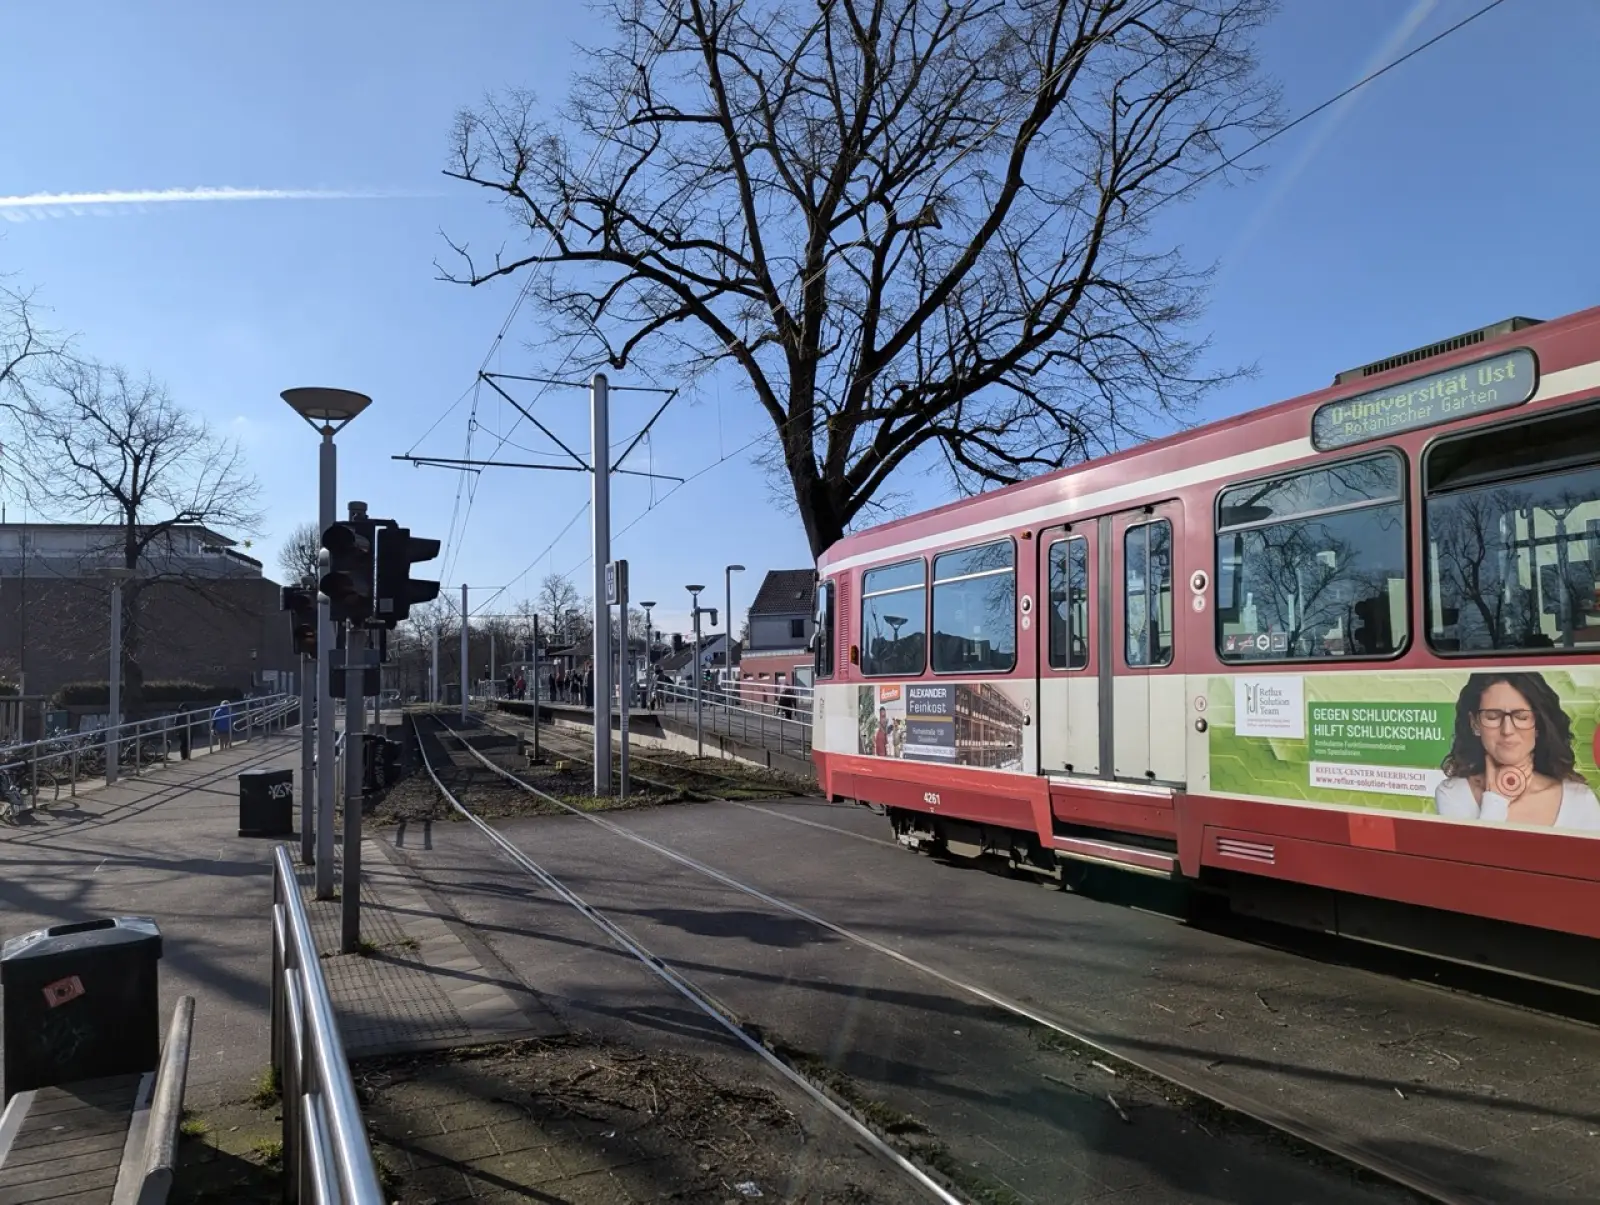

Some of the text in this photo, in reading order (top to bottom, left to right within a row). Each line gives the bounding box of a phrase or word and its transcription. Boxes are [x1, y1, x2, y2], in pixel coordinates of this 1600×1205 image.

[1344, 389, 1497, 435] Botanischer Garten
[909, 688, 947, 698] ALEXANDER
[909, 700, 947, 714] Feinkost
[1260, 697, 1290, 706] Solution
[1260, 706, 1279, 715] Team
[1313, 708, 1437, 724] GEGEN SCHLUCKSTAU
[1314, 724, 1446, 741] HILFT SCHLUCKSCHAU.
[1315, 776, 1427, 792] www.reflux-solution-team.com
